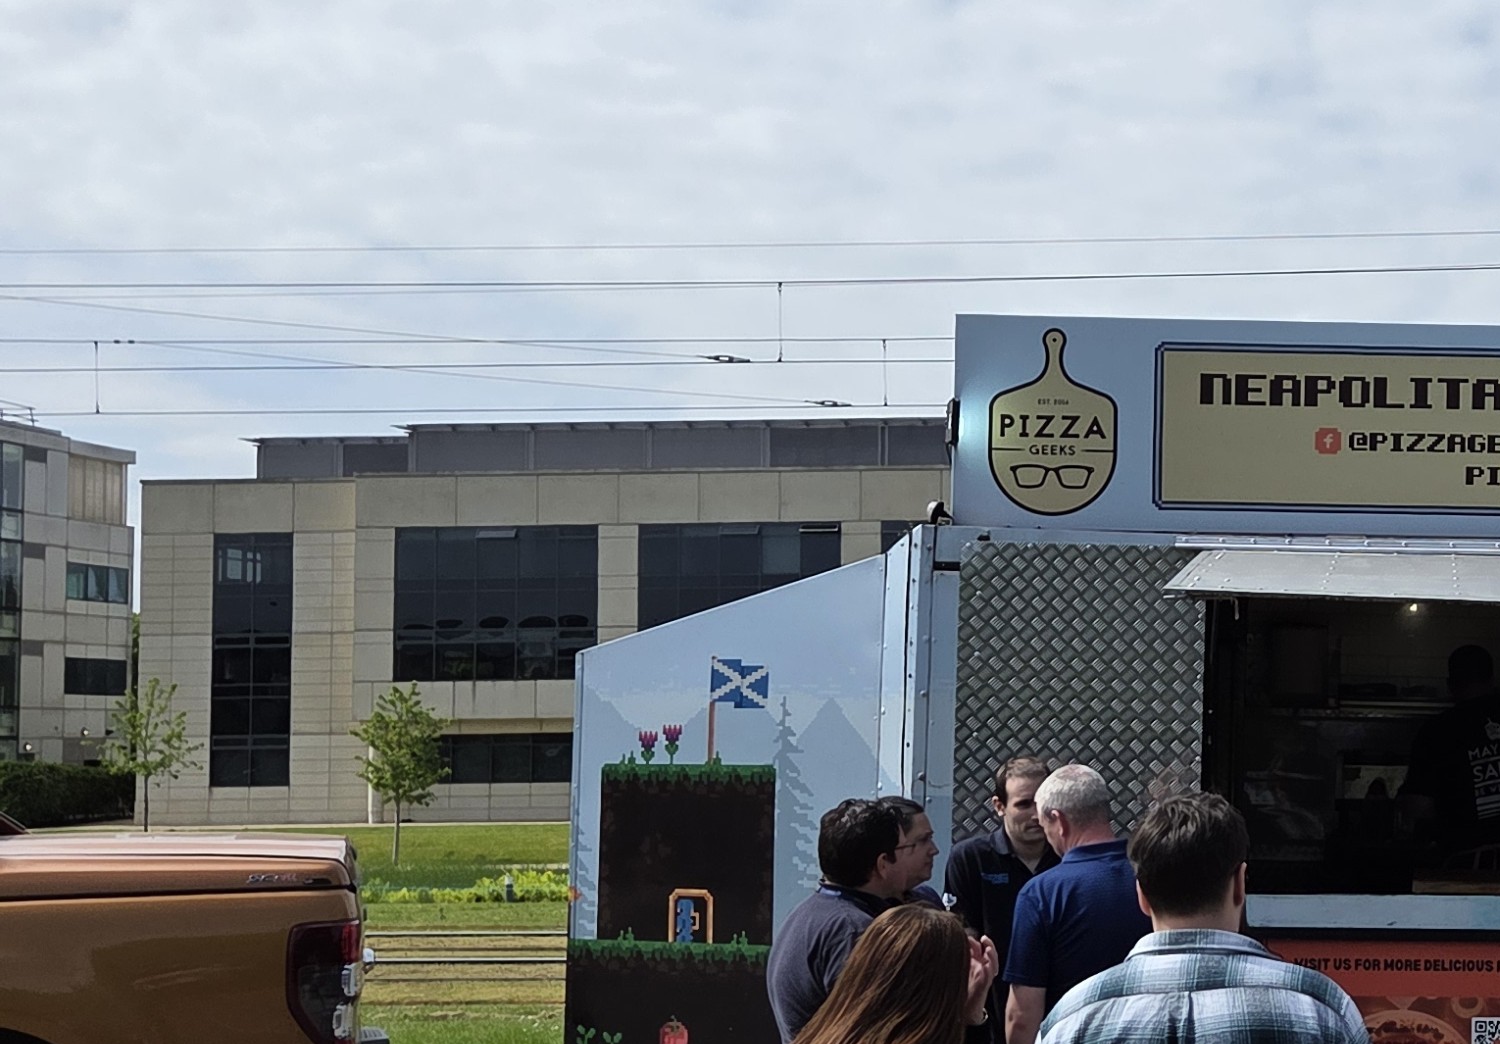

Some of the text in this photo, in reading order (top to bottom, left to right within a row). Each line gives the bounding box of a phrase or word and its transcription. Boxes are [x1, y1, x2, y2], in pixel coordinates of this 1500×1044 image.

[999, 413, 1107, 440] PIZZA
[1029, 444, 1076, 456] GEEKS
[1467, 743, 1498, 761] MAY
[1293, 957, 1331, 971] VISIT
[1333, 957, 1352, 971] US
[1354, 958, 1381, 971] FOR
[1383, 958, 1422, 972] MORE
[1423, 959, 1494, 973] DELICIOUS
